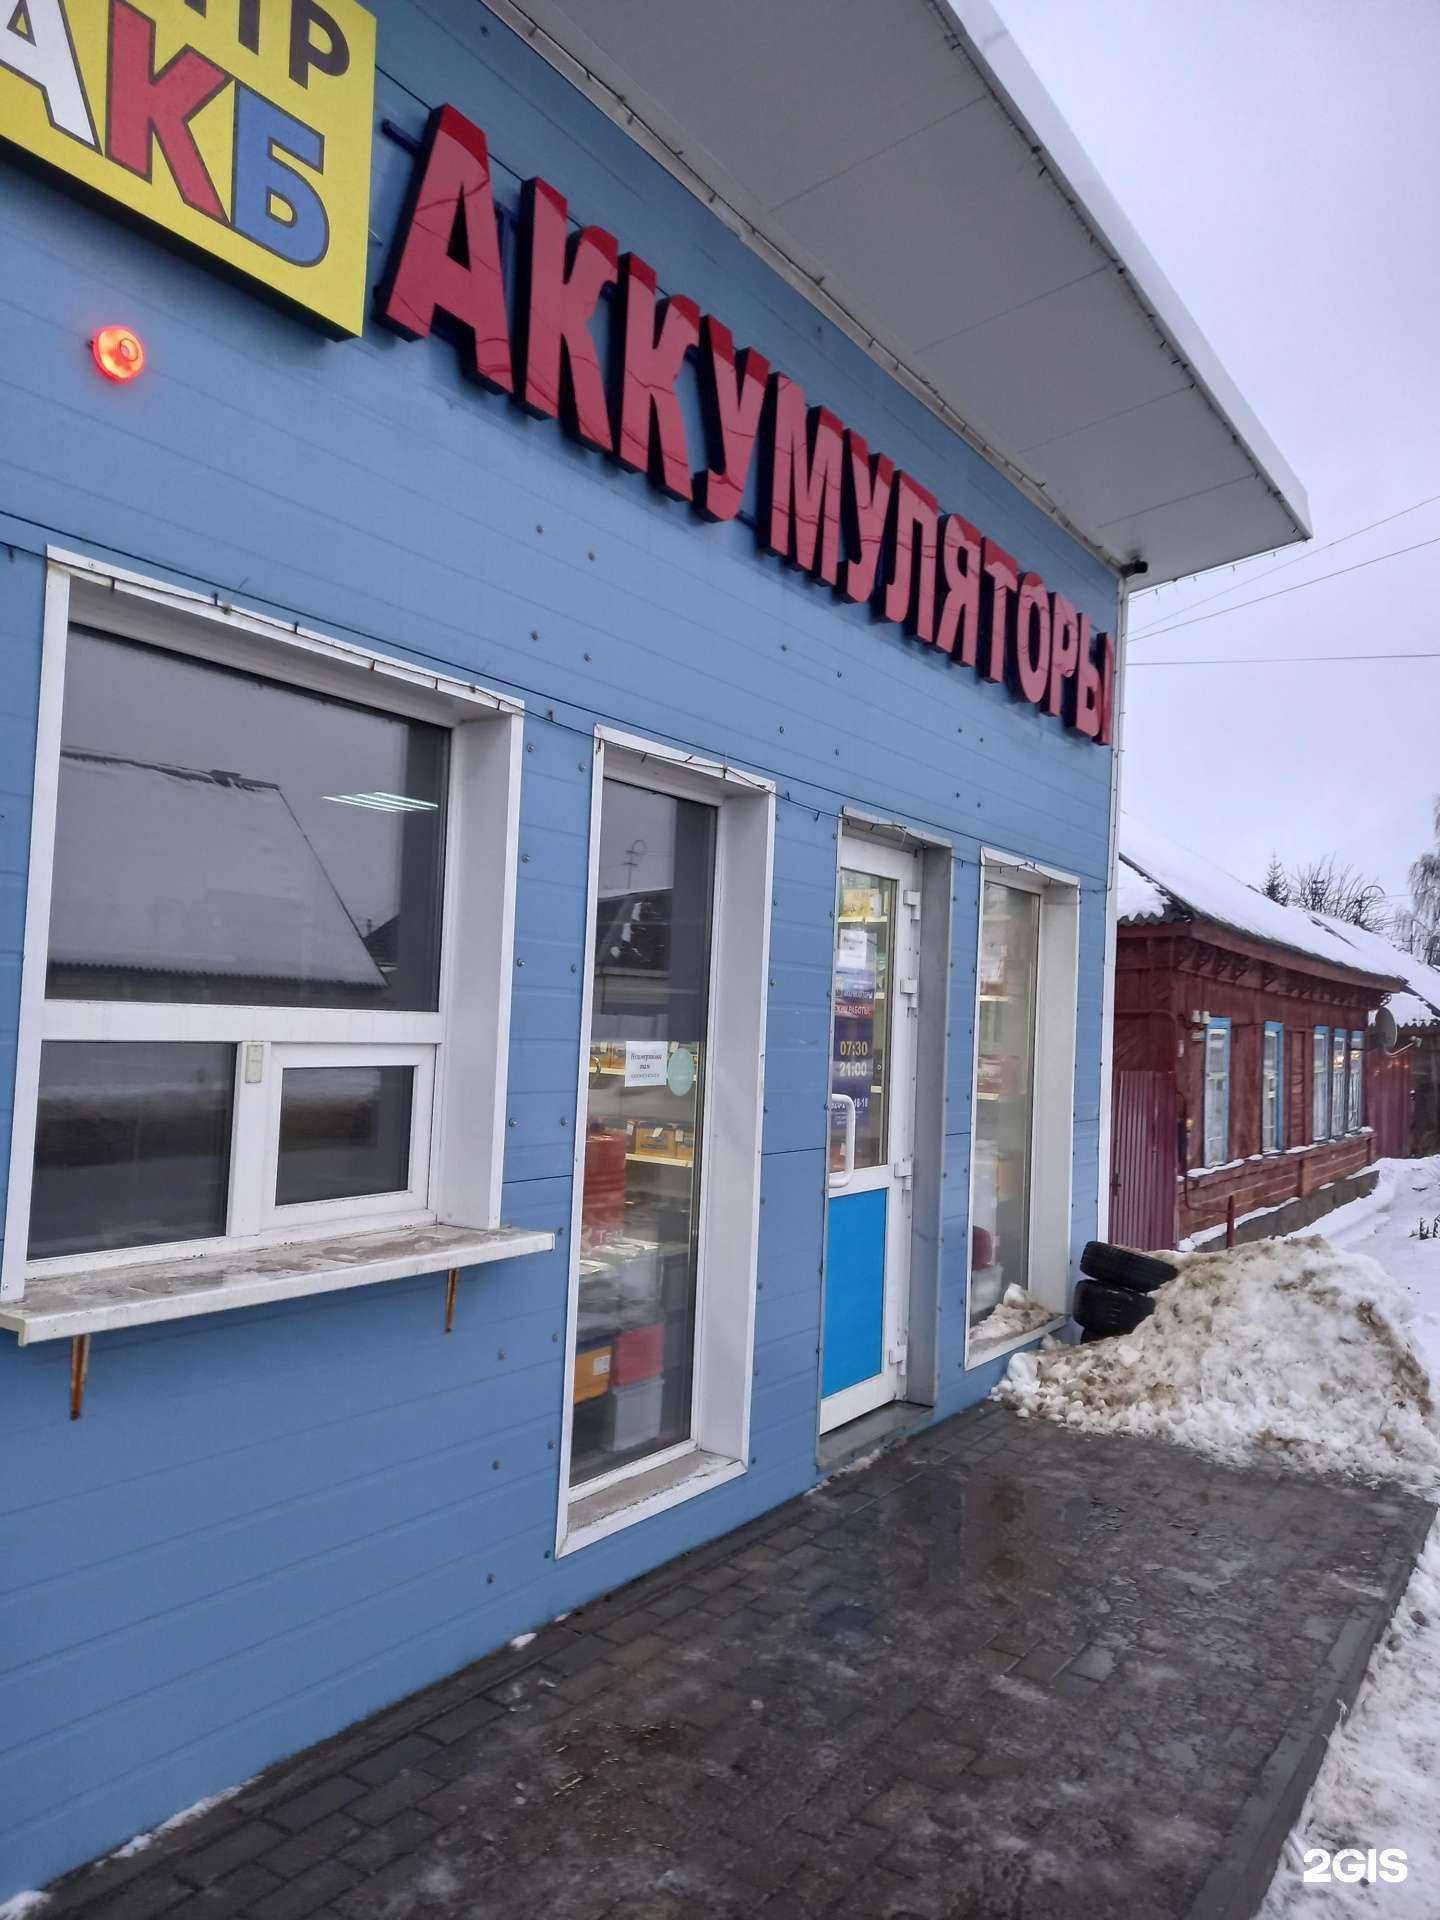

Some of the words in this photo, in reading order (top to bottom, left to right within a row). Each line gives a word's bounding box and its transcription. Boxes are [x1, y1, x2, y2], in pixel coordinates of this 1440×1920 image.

[0, 0, 330, 268] АКБ
[375, 103, 1114, 746] АККУМУЛЯТОРЫ
[839, 1062, 868, 1077] 21:00
[840, 1041, 868, 1056] 07:30
